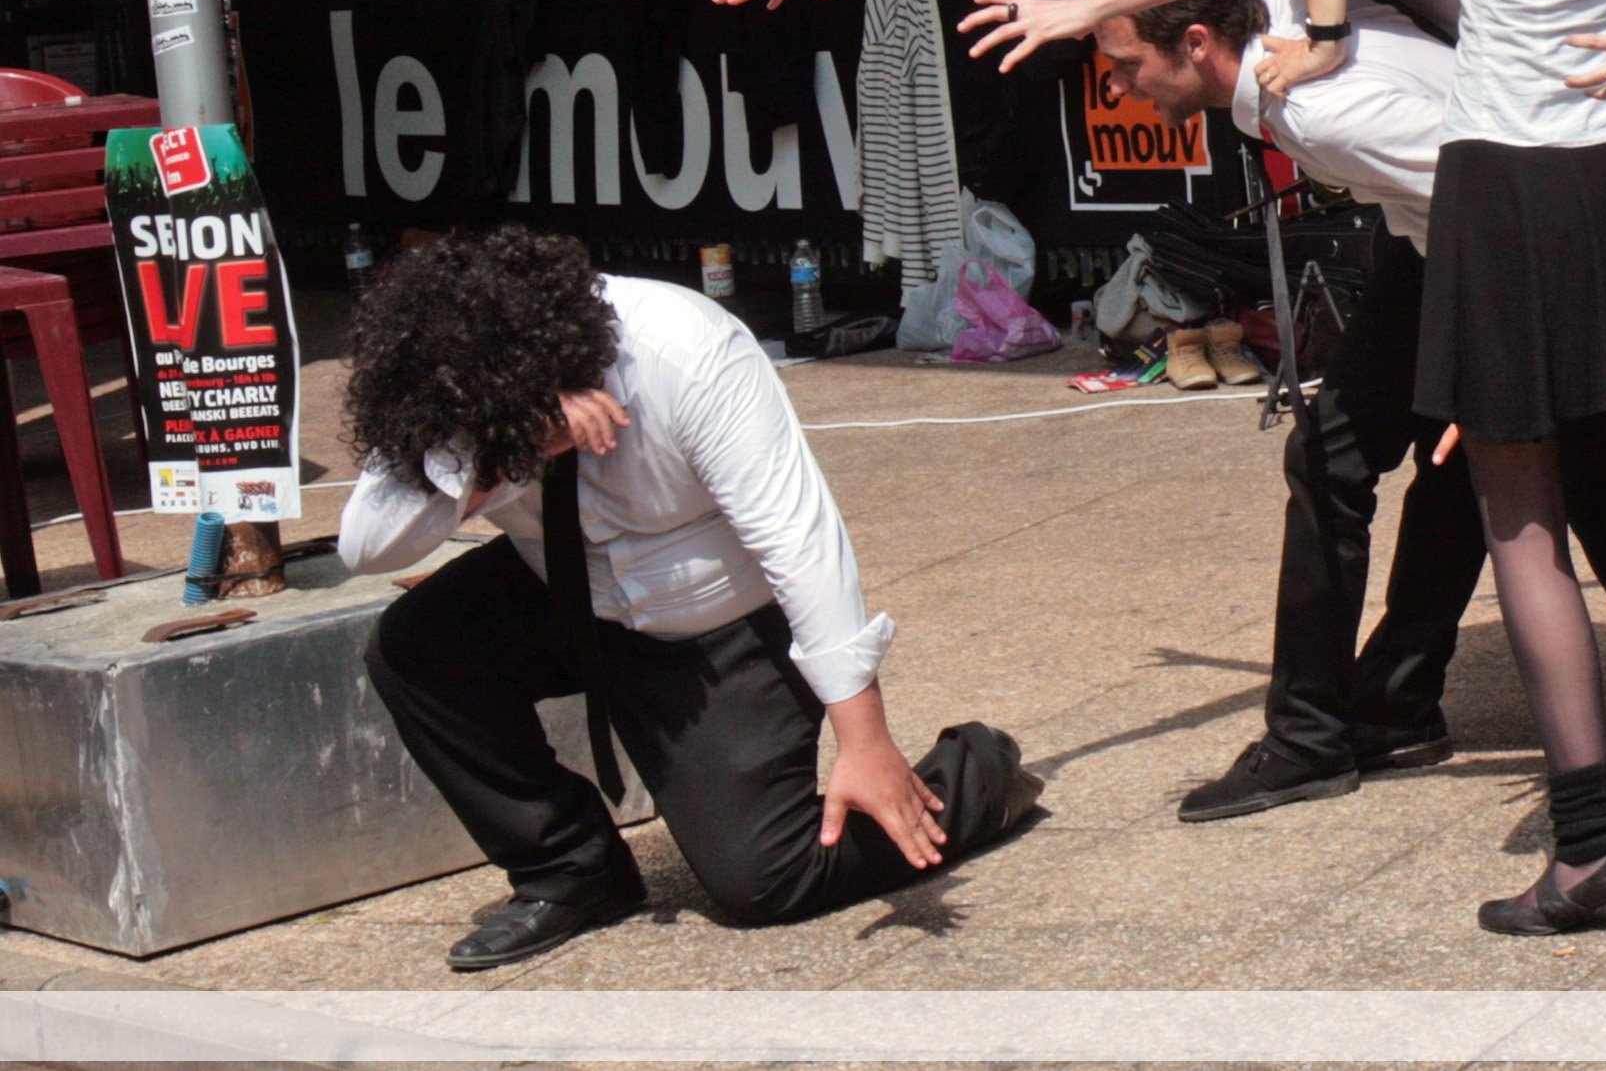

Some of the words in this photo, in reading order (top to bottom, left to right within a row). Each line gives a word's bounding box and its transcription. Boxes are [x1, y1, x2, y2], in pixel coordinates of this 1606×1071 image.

[1087, 60, 1121, 110] le
[329, 10, 446, 202] le
[183, 357, 200, 374] de
[201, 354, 276, 374] Bourges
[203, 385, 278, 408] CHARLY
[234, 439, 259, 452] DVD
